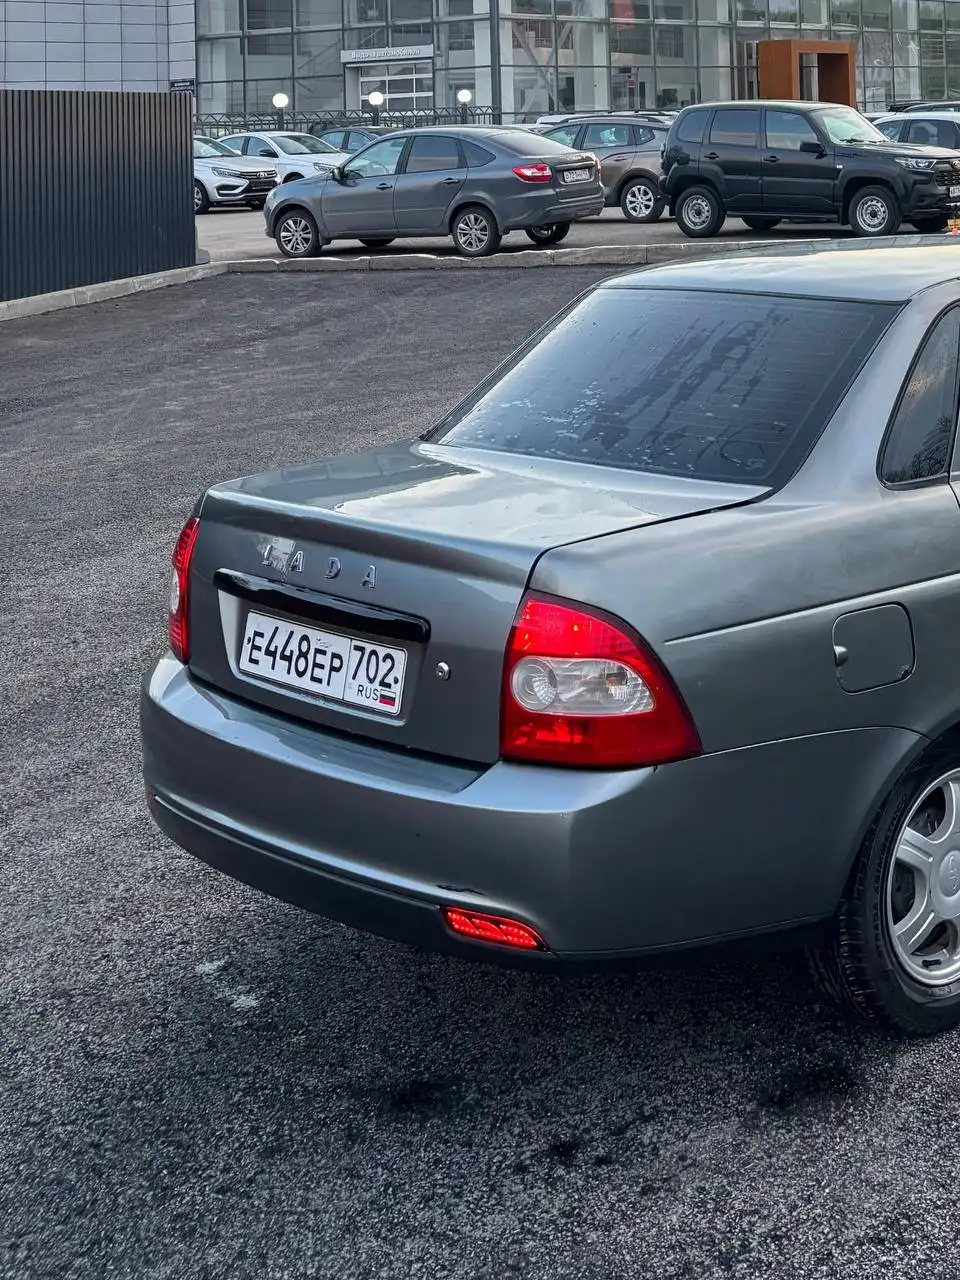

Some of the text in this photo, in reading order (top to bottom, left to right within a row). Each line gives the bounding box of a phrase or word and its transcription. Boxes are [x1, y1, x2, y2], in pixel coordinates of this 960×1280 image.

[261, 544, 378, 589] LADA
[351, 645, 396, 689] 702
[357, 684, 379, 701] RUS
